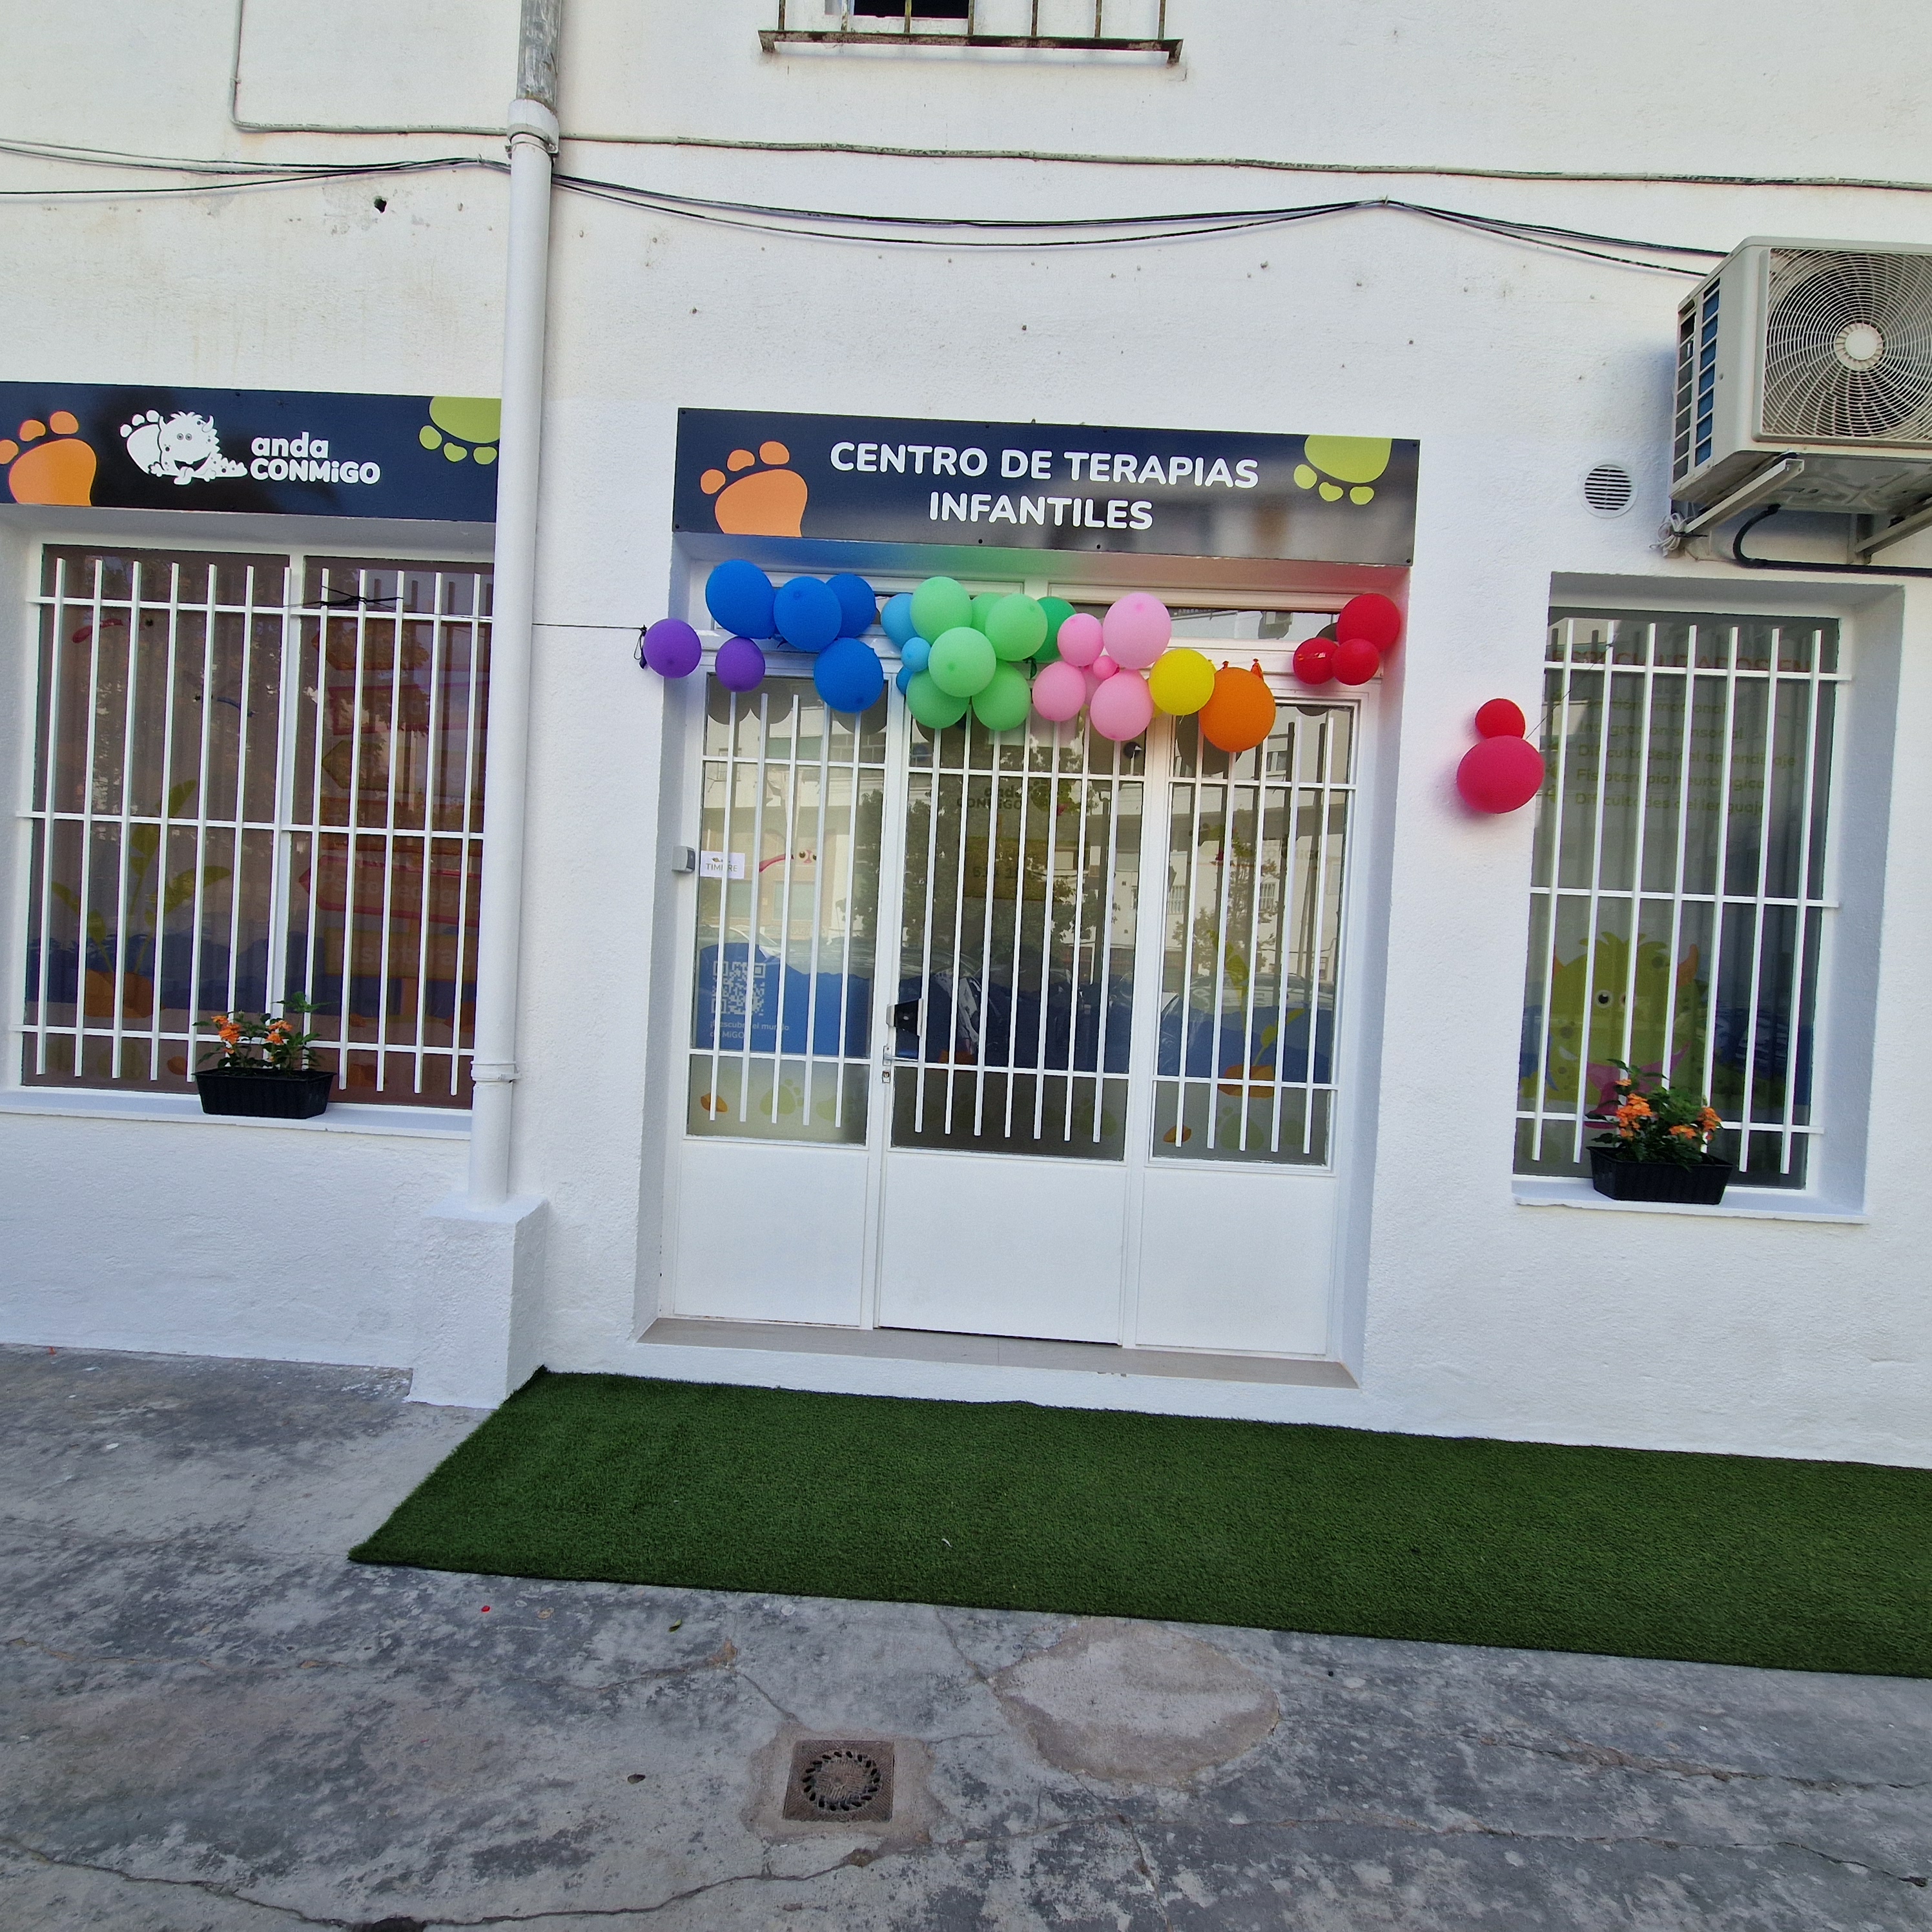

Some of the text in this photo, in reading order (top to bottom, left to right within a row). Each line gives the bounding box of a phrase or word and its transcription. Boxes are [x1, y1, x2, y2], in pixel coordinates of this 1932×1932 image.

[251, 431, 329, 458] anda
[830, 442, 1259, 489] CENTRO DE TERAPIAS
[929, 491, 1153, 530] INFANTILES
[705, 863, 738, 872] TIMRE
